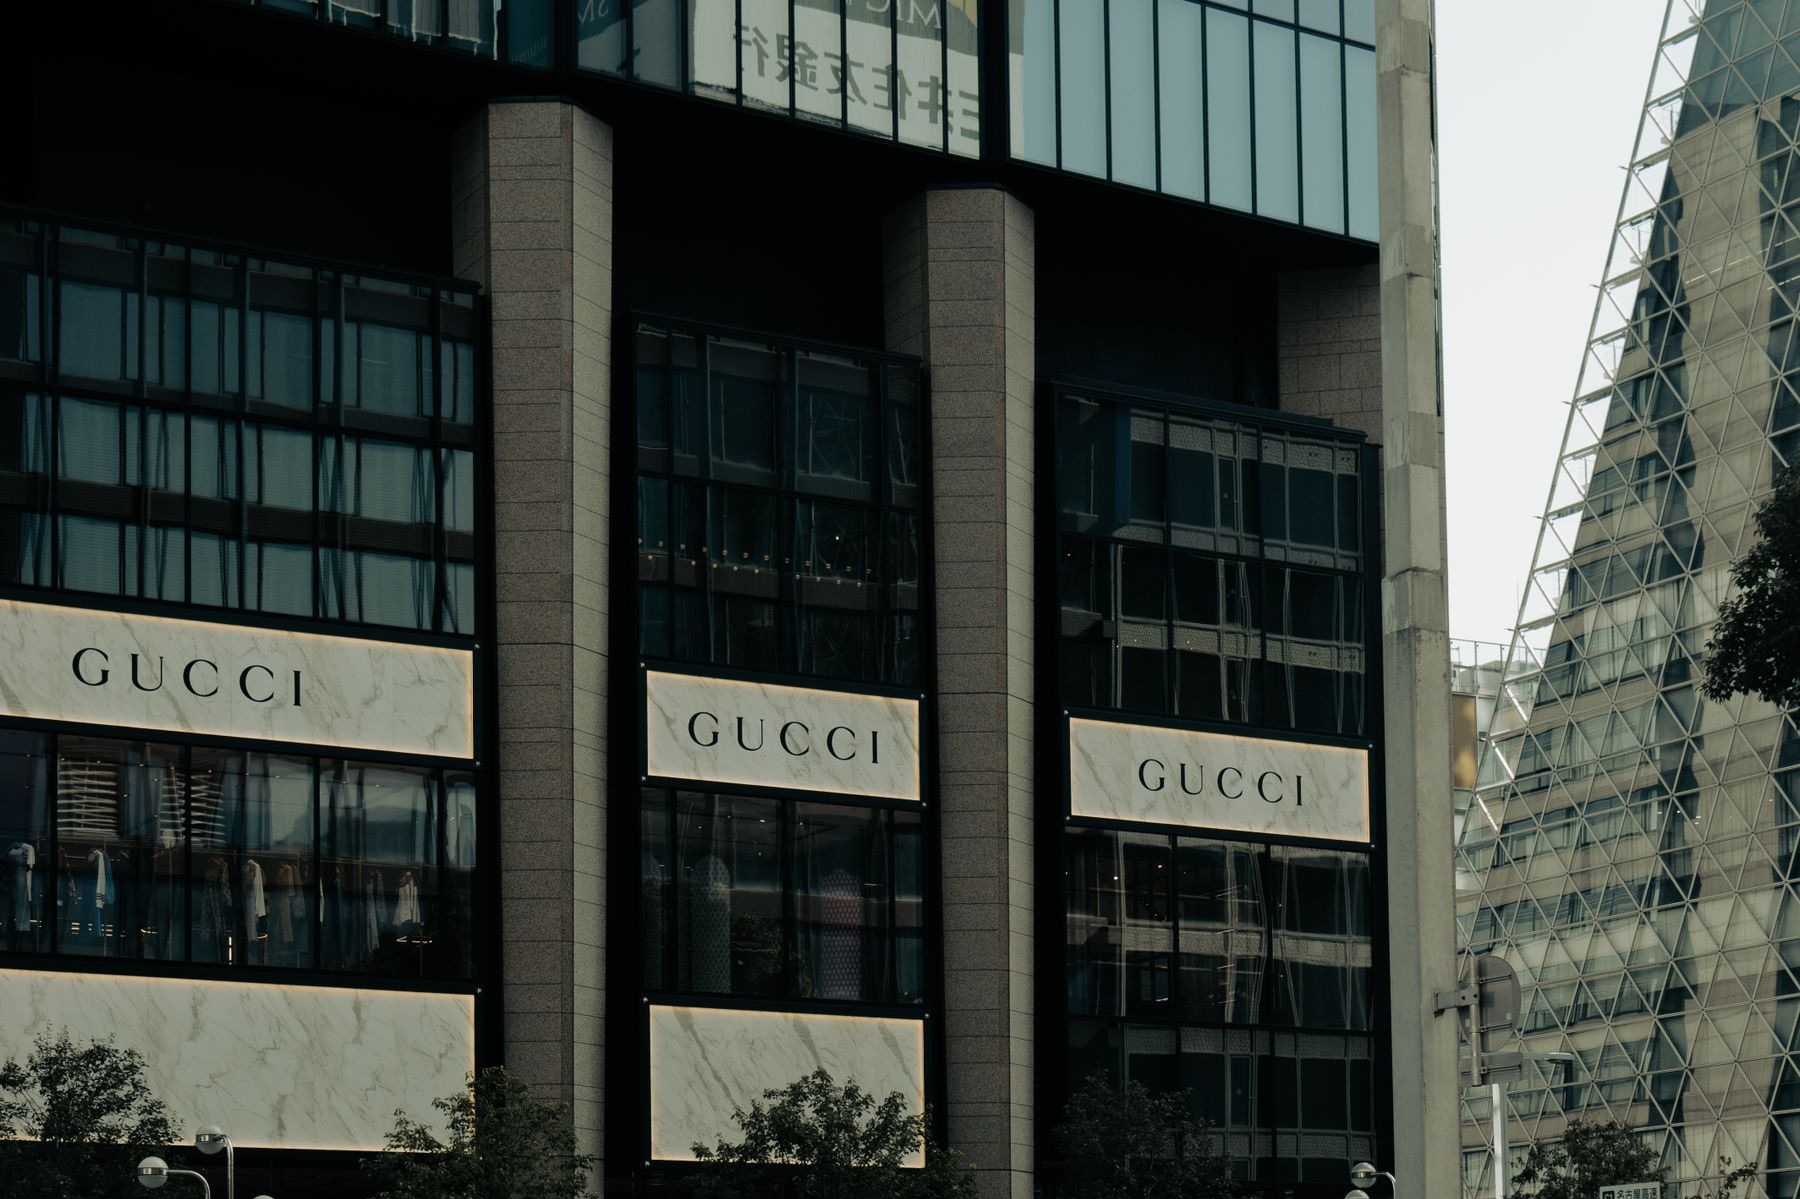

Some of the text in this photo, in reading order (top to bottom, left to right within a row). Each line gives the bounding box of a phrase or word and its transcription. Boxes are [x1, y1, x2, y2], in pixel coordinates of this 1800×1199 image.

[72, 647, 302, 706] GUCCI
[688, 711, 879, 764] GUCCI
[1138, 758, 1302, 806] GUCCI
